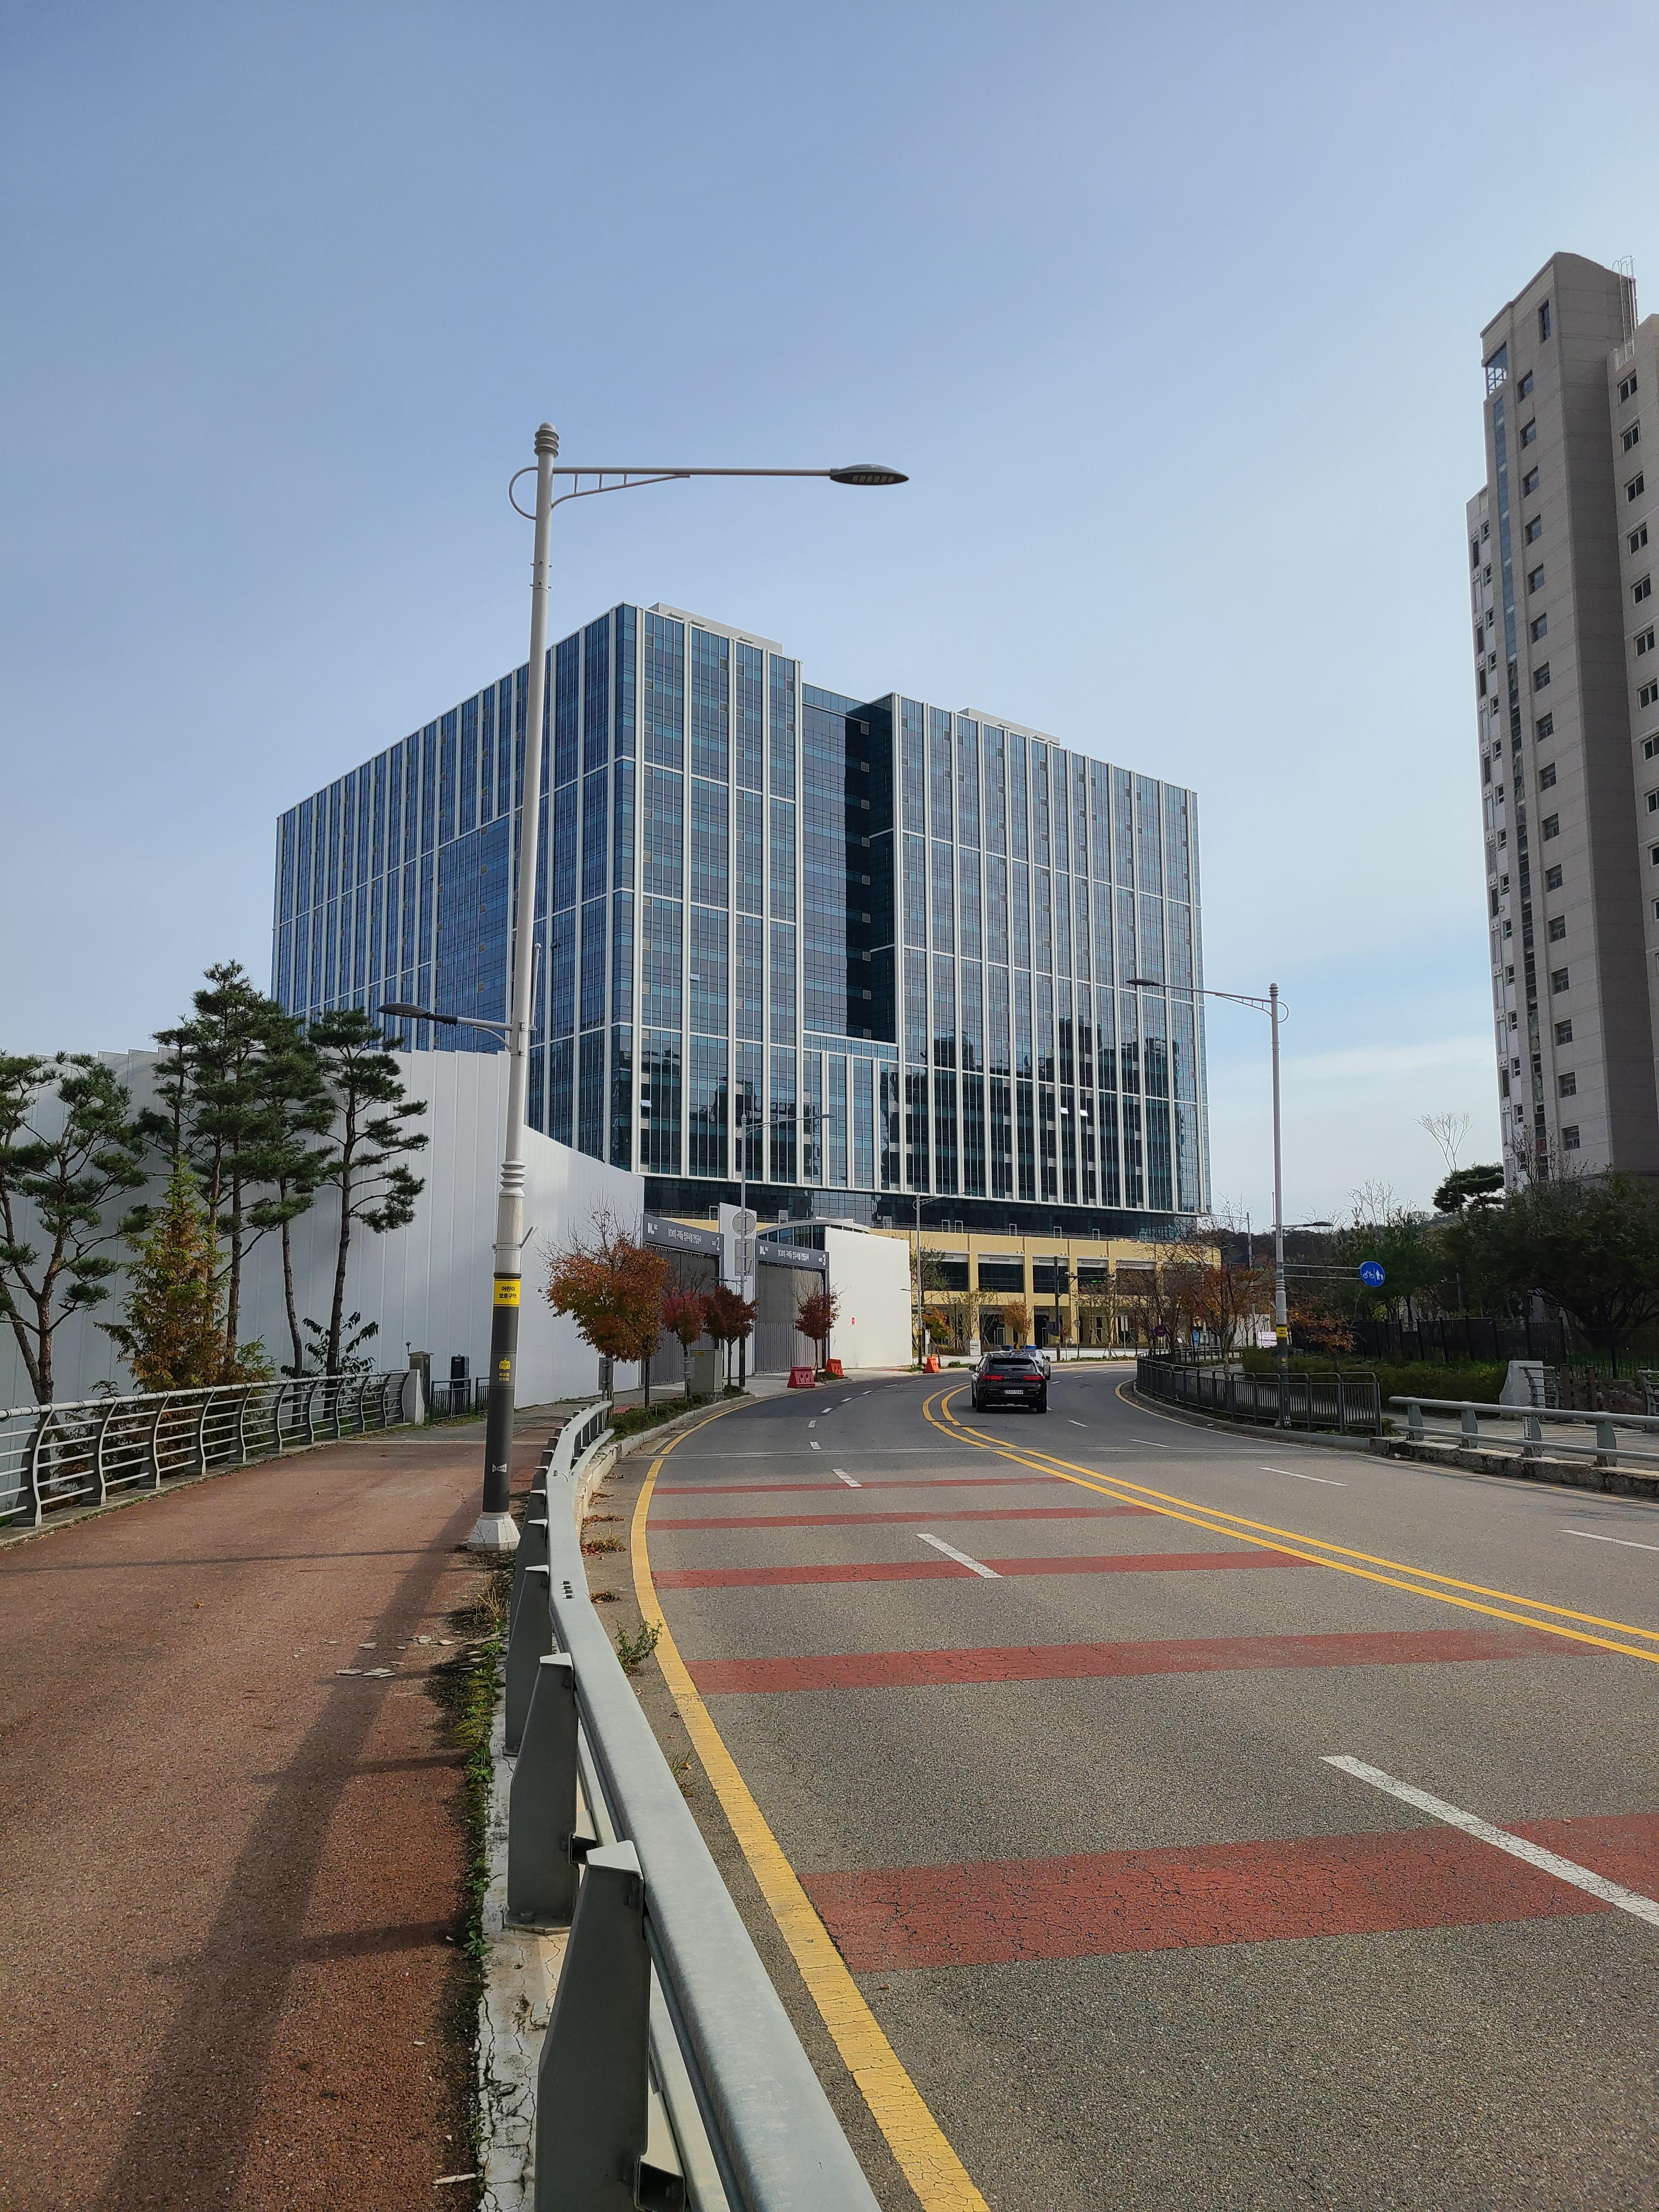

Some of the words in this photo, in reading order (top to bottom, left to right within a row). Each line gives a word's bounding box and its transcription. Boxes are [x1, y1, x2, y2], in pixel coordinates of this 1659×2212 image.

[647, 1222, 654, 1234] DL
[716, 1237, 720, 1251] 2
[759, 1245, 766, 1255] DL
[822, 1254, 826, 1266] 3
